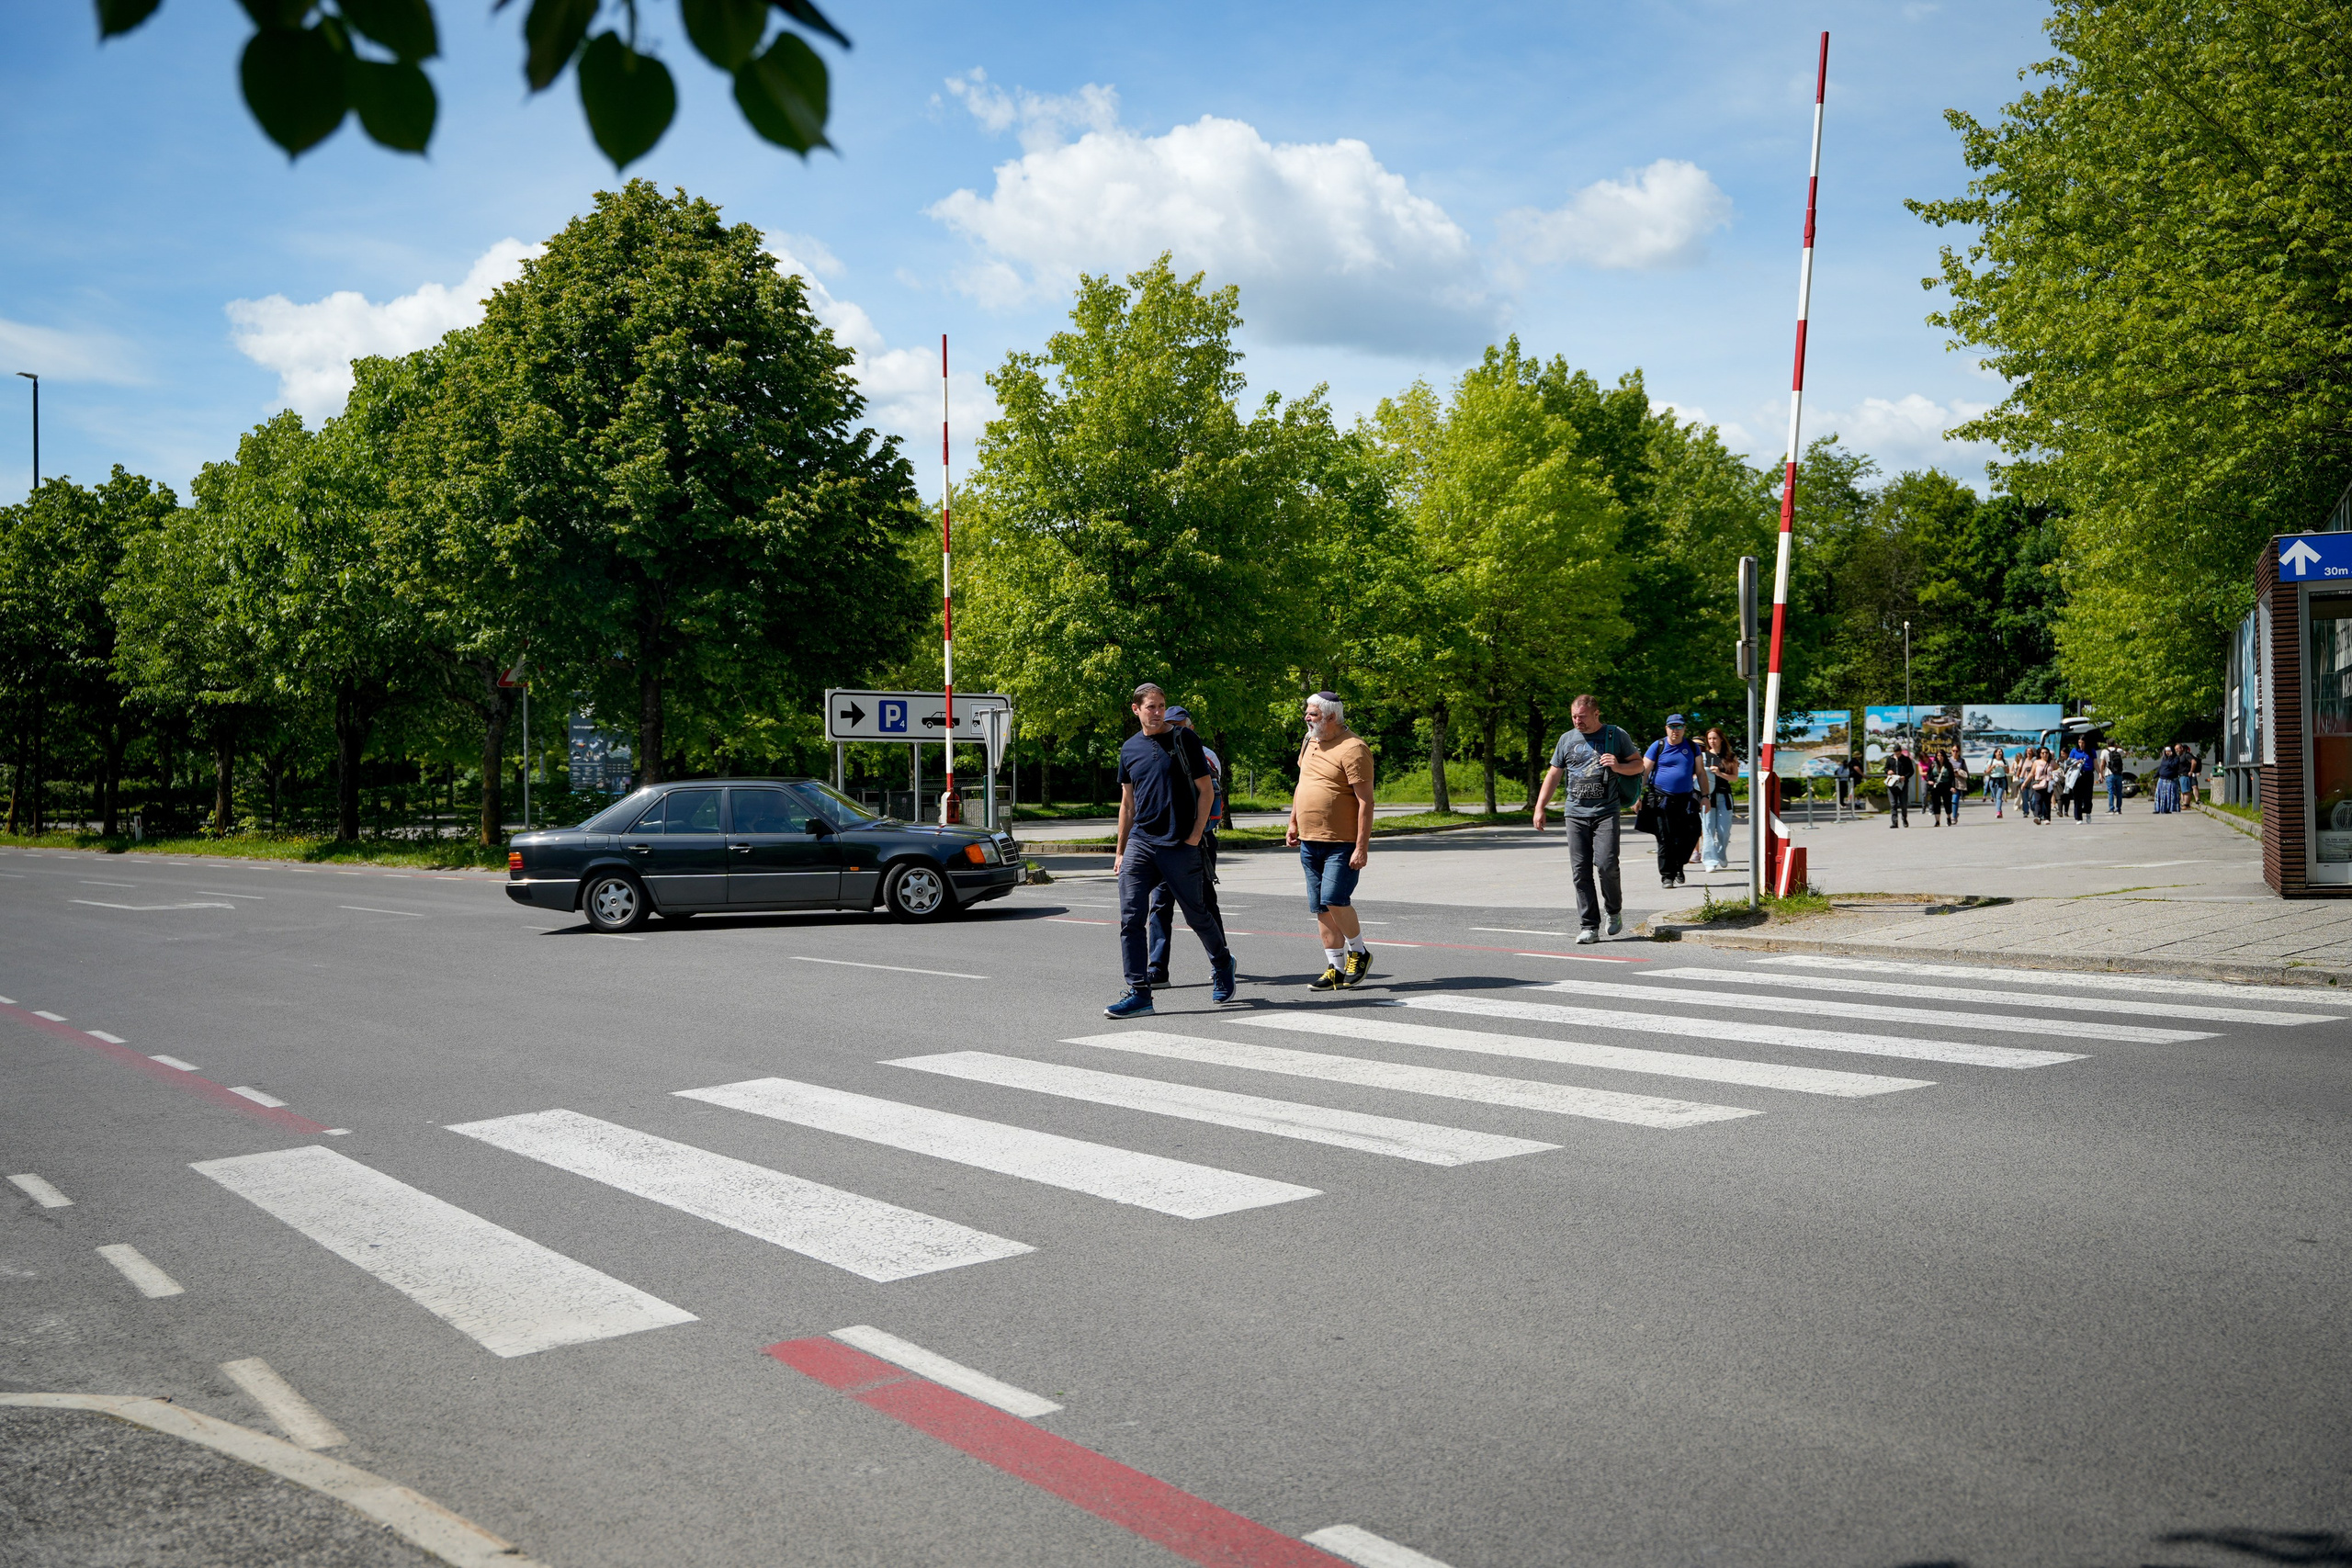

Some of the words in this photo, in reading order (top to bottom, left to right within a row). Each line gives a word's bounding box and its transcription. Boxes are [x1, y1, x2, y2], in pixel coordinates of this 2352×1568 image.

[2324, 567, 2348, 576] 30m
[886, 705, 901, 728] P
[899, 720, 905, 728] 4
[1573, 783, 1604, 791] STAR
[1570, 790, 1604, 799] WARS
